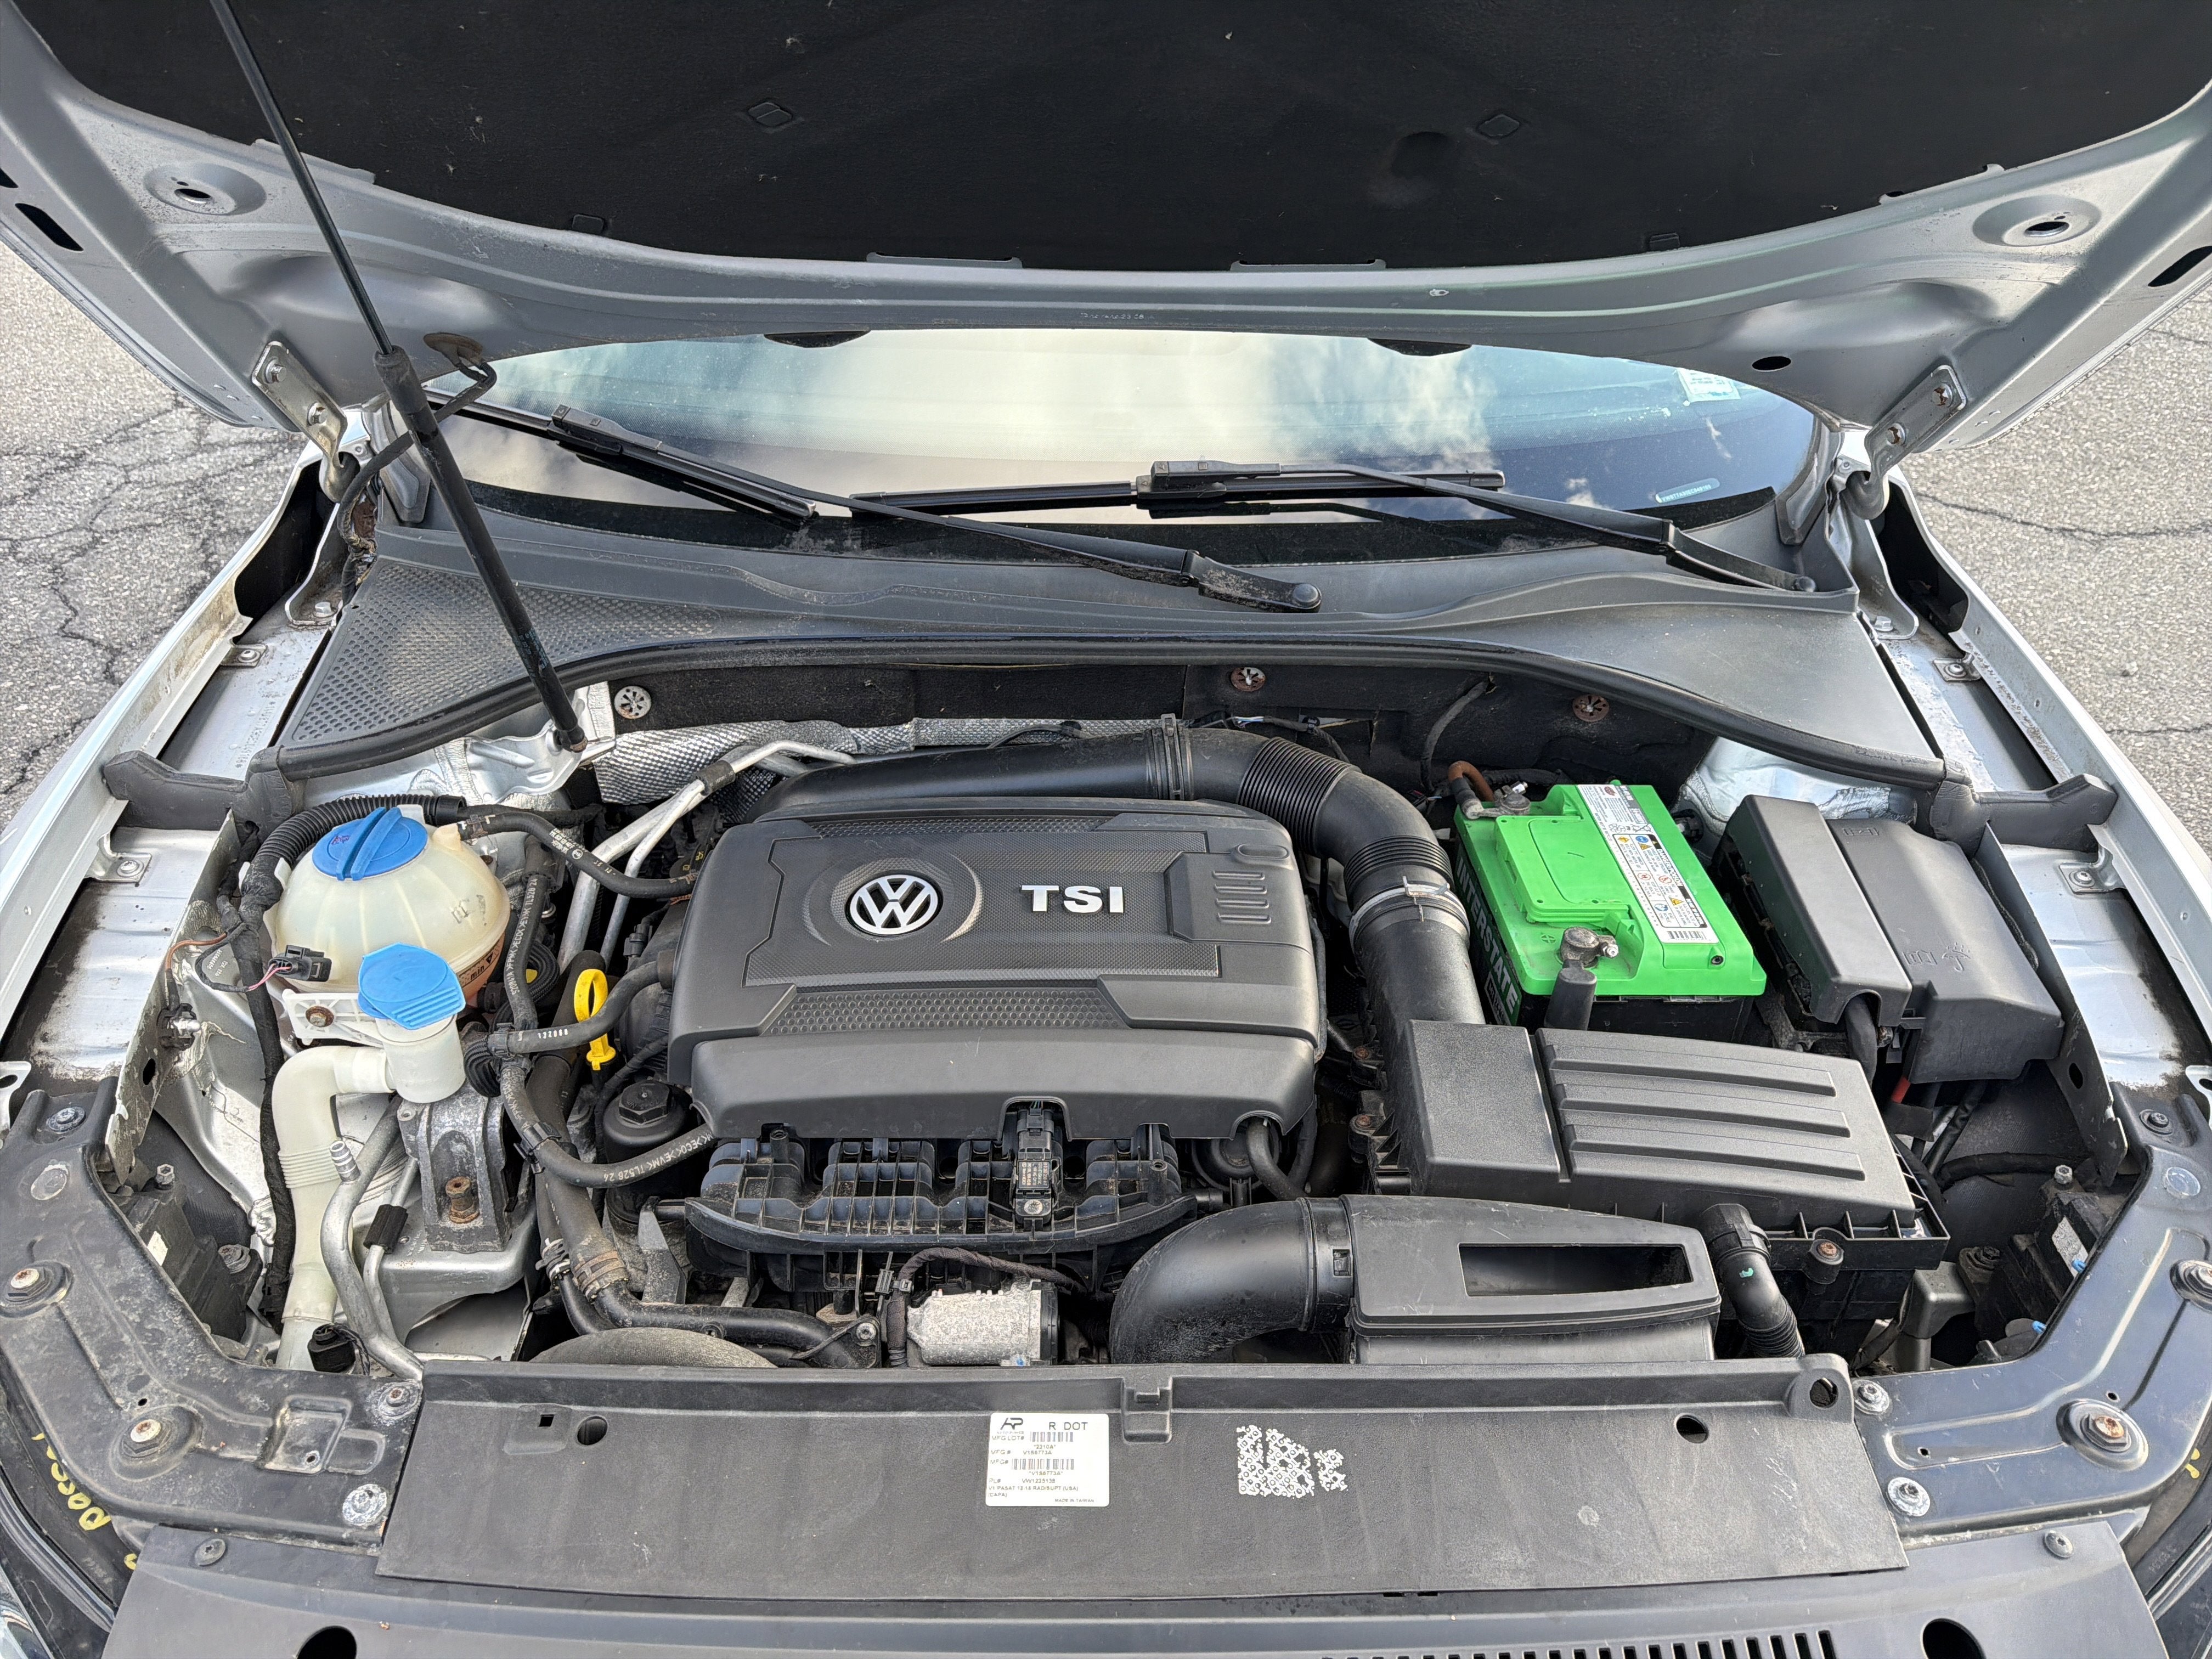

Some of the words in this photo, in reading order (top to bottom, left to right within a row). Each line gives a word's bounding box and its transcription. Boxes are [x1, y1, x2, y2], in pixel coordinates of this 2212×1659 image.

[1020, 884, 1125, 913] TSI
[1457, 856, 1519, 1015] INTERSTATE
[470, 965, 484, 980] min
[1048, 1421, 1057, 1431] R
[1064, 1421, 1088, 1431] DOT
